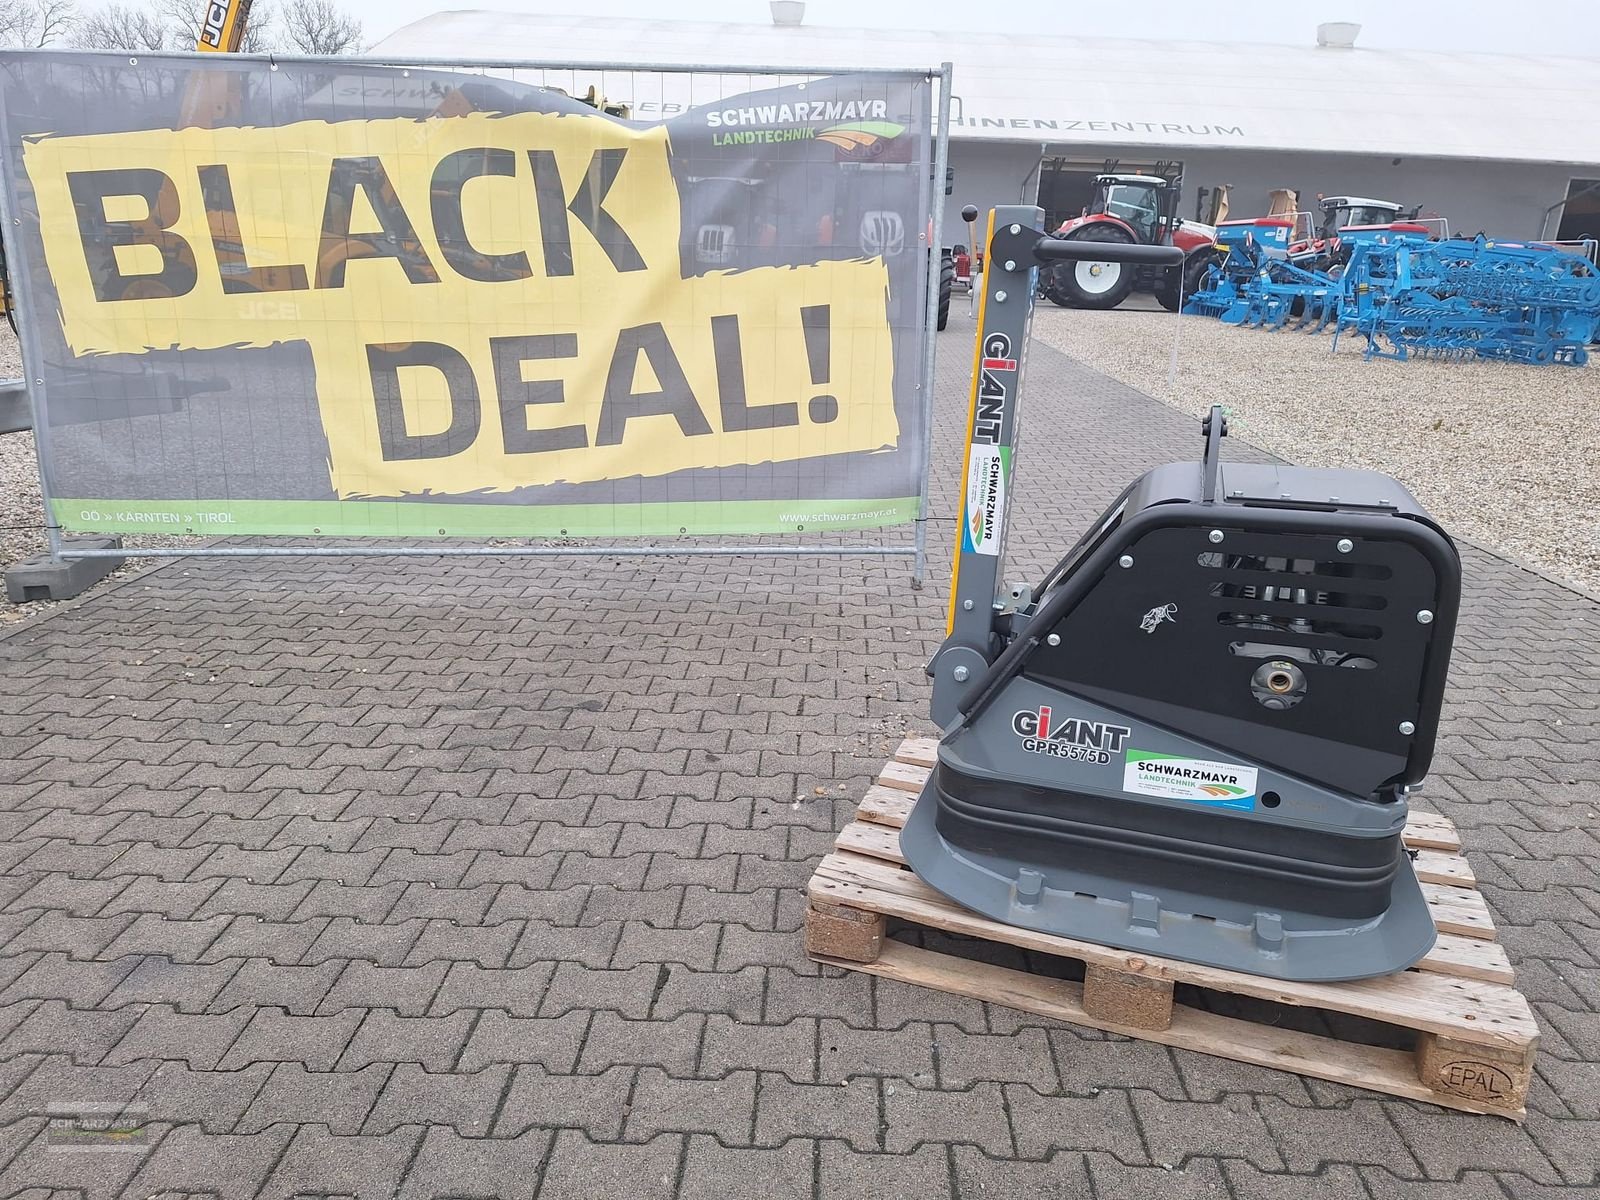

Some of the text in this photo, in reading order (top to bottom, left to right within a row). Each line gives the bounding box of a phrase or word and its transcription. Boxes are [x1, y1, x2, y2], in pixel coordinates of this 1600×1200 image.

[707, 100, 887, 128] SCHWARZMAYR
[712, 127, 816, 147] LANDTECHNIK
[65, 147, 648, 303] BLACK
[365, 304, 839, 462] DEAL!
[979, 457, 989, 506] LANDTECHNIK
[984, 456, 1000, 540] SCHWARZMAYR
[80, 510, 236, 523] OÖ KÄRNTEN TIROL
[780, 508, 897, 522] www.schwarzmayr.at
[1022, 738, 1111, 765] GPR5575D
[1138, 761, 1238, 785] SCHWARZMAYR
[1138, 773, 1197, 788] LANDTECHNIK
[1449, 1066, 1501, 1093] EPAL
